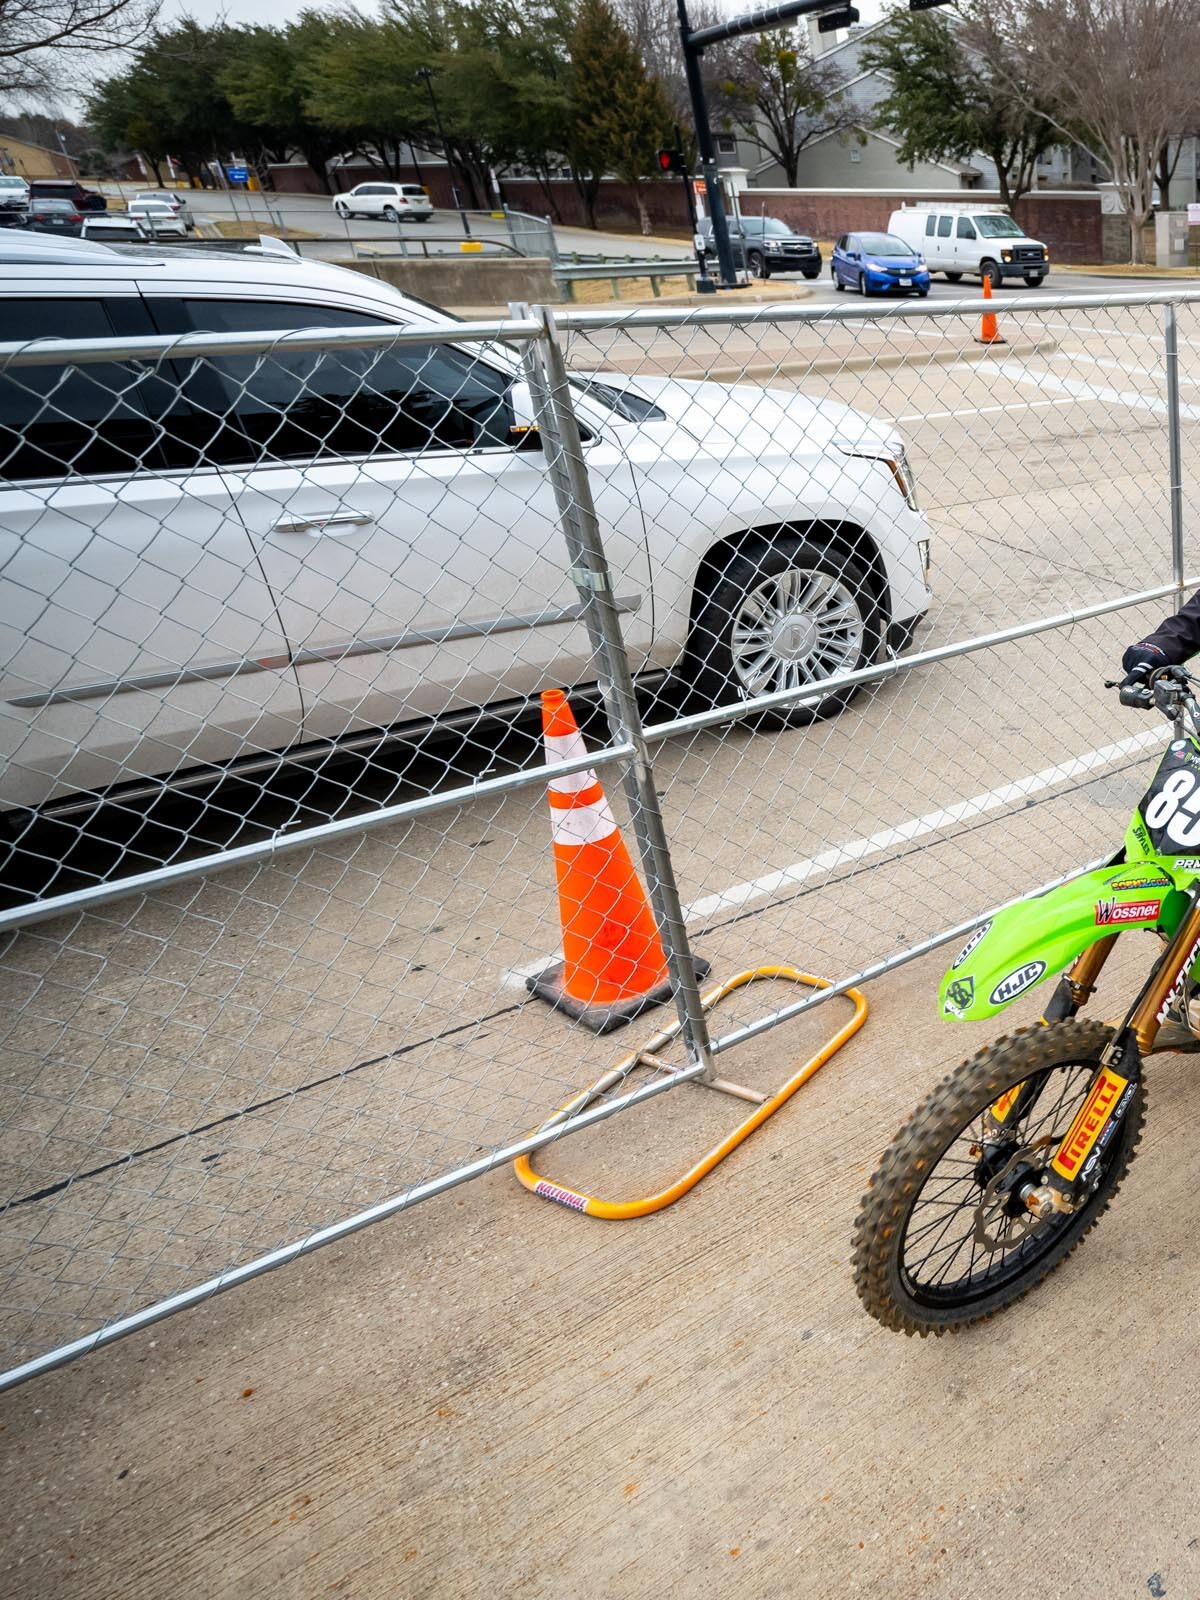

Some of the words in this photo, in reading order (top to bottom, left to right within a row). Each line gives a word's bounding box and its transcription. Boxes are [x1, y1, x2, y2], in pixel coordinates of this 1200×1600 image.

[1097, 897, 1159, 924] Wössner
[997, 963, 1040, 1001] HJC
[1058, 1075, 1120, 1171] PIRELLI
[537, 1182, 587, 1208] NATIONAL
